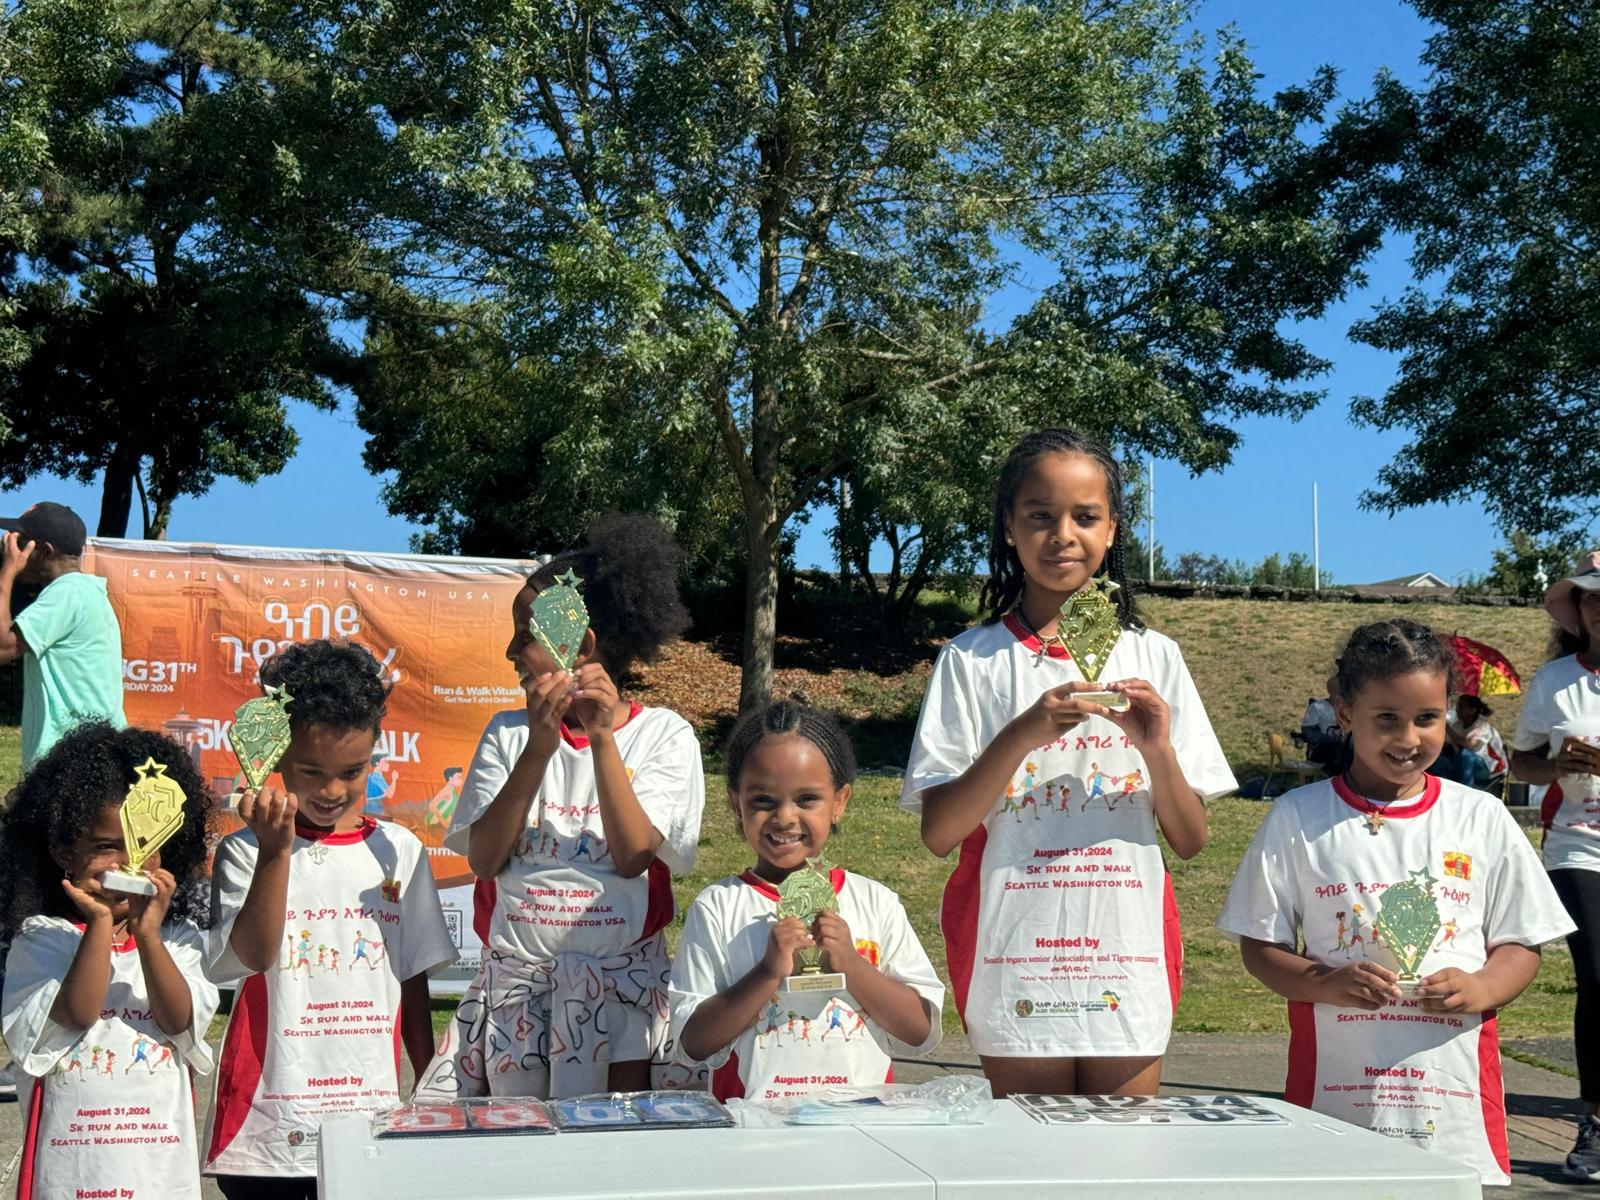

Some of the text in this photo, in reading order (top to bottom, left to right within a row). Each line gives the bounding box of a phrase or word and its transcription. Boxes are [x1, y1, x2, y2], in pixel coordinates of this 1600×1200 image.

[132, 568, 490, 600] SEATTLE WASHINGTON USA
[122, 659, 197, 683] G31TH
[123, 682, 175, 692] RDAY 2024
[433, 685, 454, 695] Run
[455, 686, 464, 695] &
[466, 686, 492, 695] Walk
[372, 730, 421, 763] ALK
[1033, 847, 1113, 859] August 31,2024
[1125, 880, 1143, 889] USA
[526, 887, 595, 898] August 31,2024
[604, 917, 626, 926] USA
[1035, 937, 1100, 949] Hosted by
[1029, 955, 1050, 963] senior
[1052, 954, 1094, 963] Association
[1097, 954, 1110, 962] and
[306, 1000, 374, 1011] August 31,2024
[1447, 1018, 1464, 1028] USA
[1364, 1066, 1426, 1080] Hosted by
[308, 1076, 363, 1088] Hosted by
[774, 1075, 848, 1085] August 31,2024
[1378, 1082, 1419, 1091] Association
[76, 1107, 151, 1118] August 31,2024
[160, 1135, 180, 1144] USA
[76, 1187, 134, 1200] Hosted by
